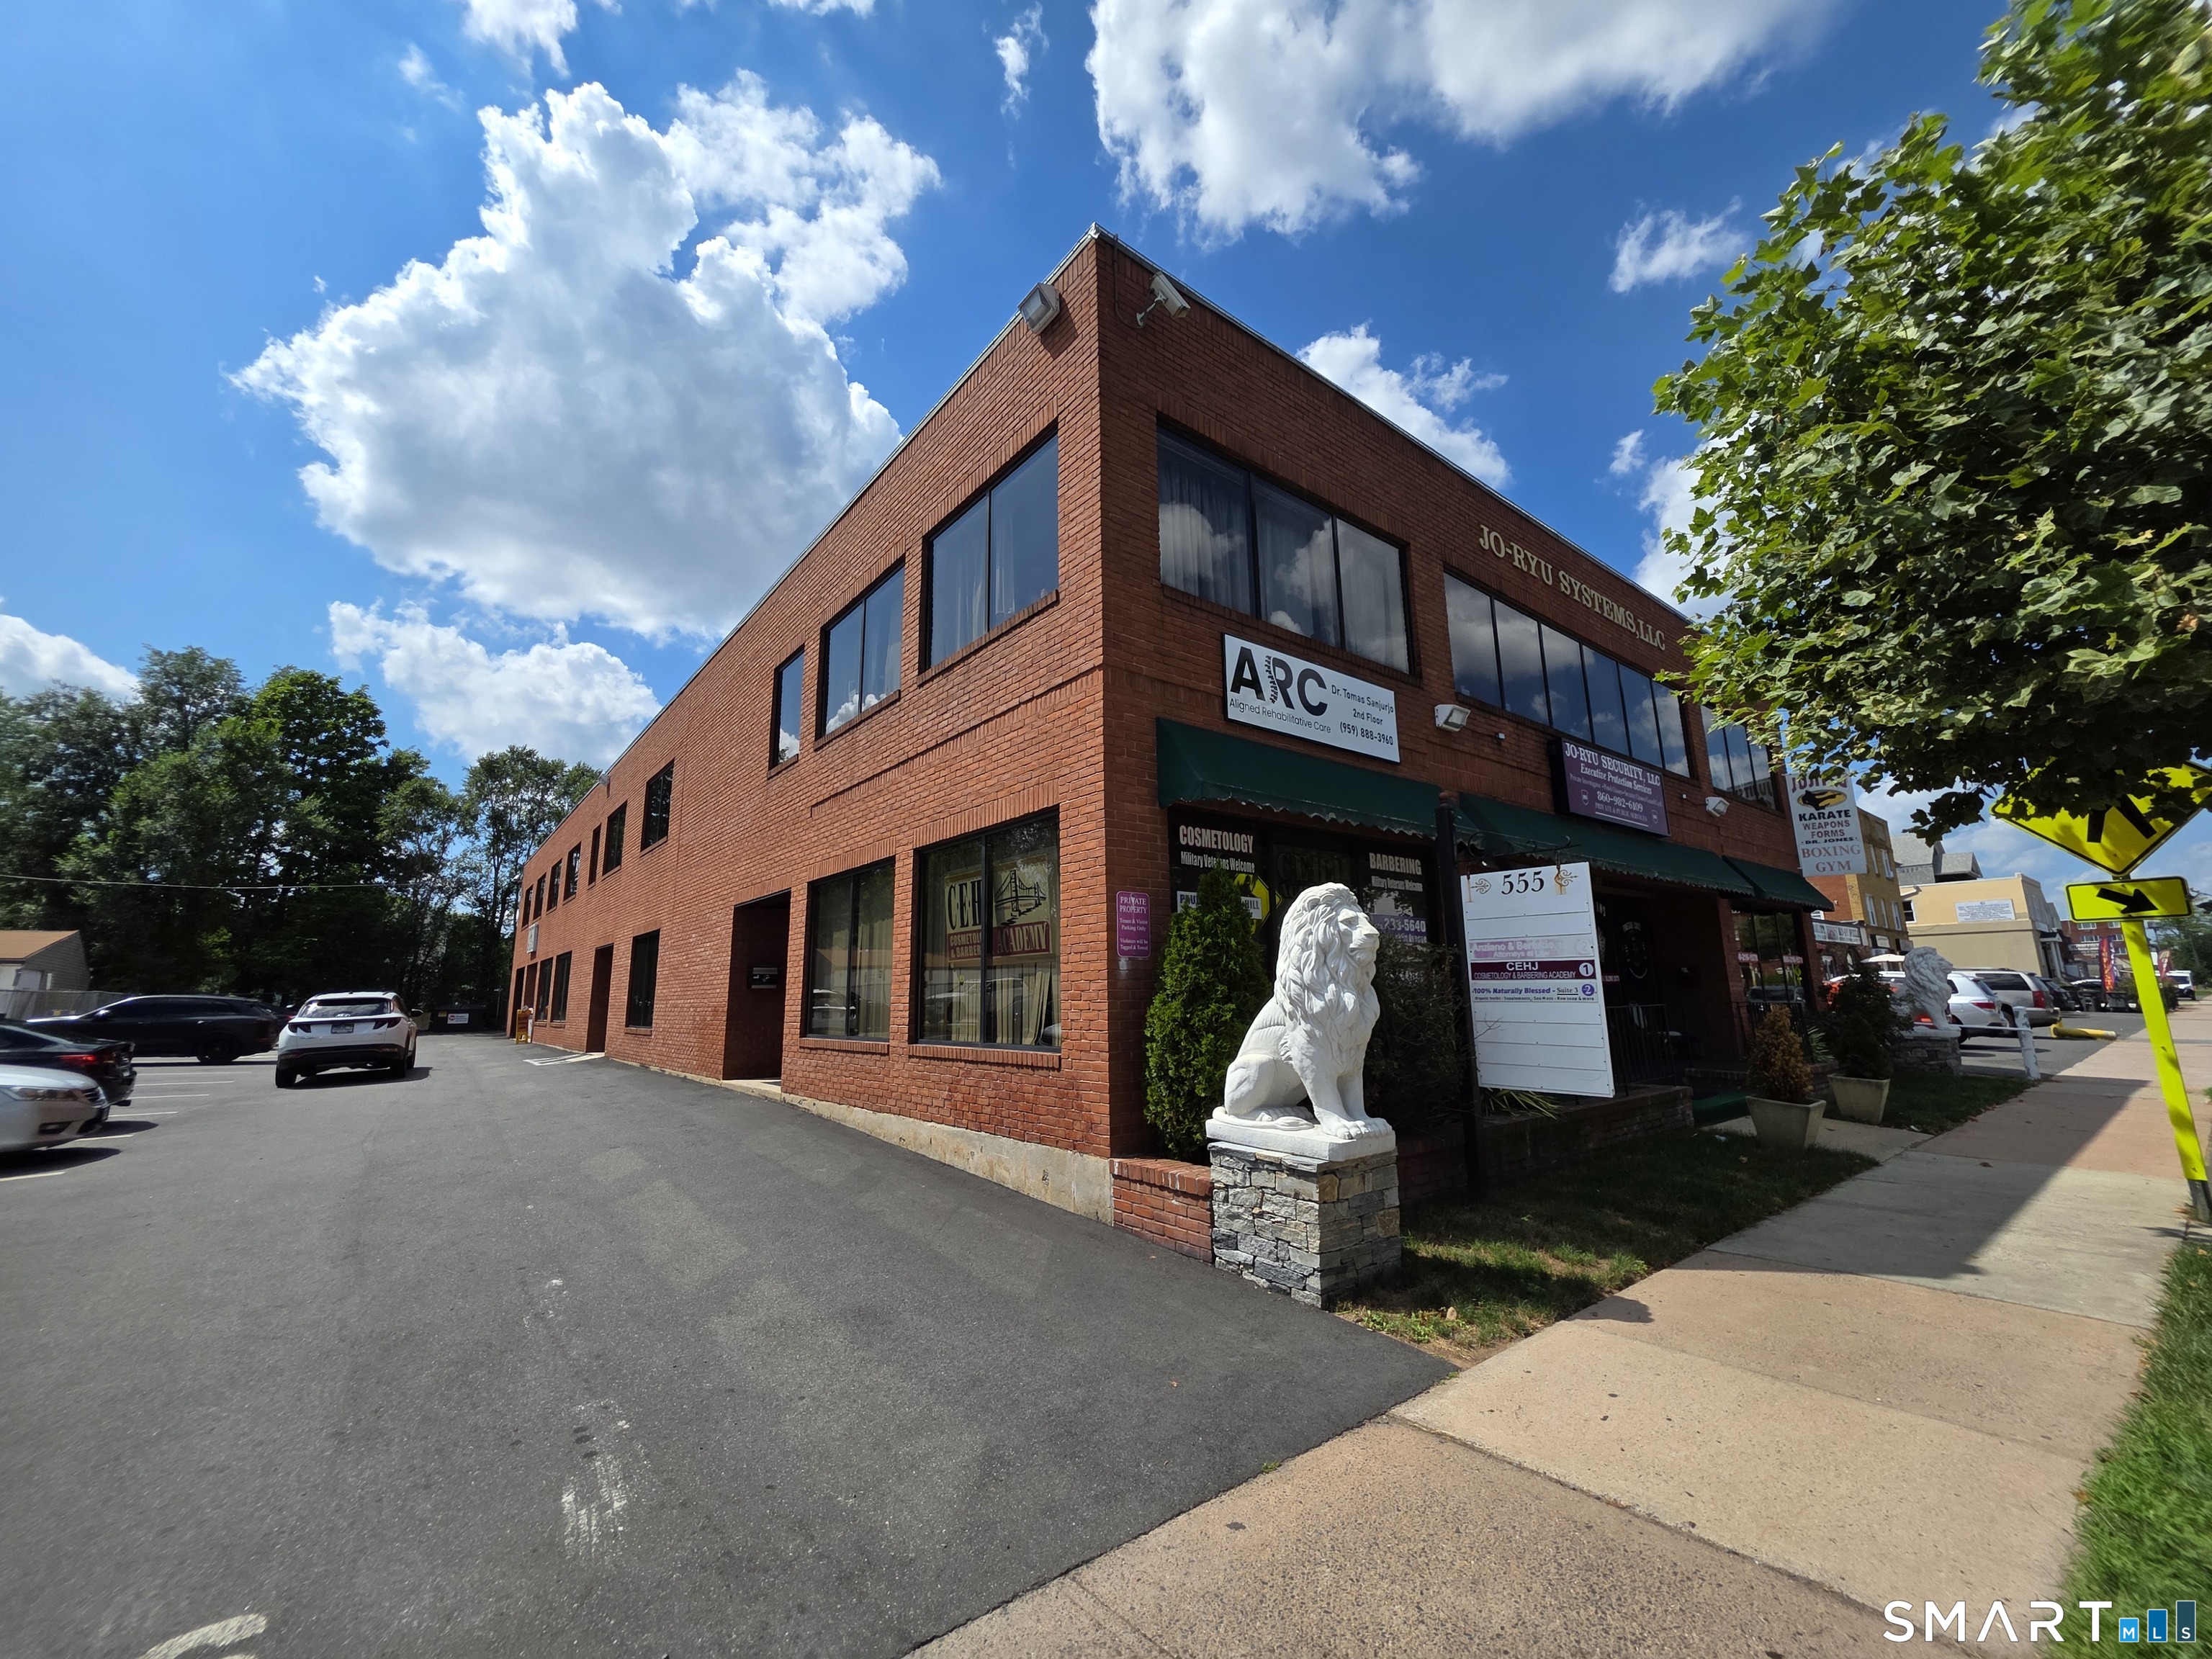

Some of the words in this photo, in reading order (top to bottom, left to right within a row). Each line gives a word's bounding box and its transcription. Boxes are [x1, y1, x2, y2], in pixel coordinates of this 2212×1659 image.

[1479, 524, 1552, 585] JO-RYU
[1231, 646, 1328, 716] ARC
[1331, 685, 1341, 696] Dr.
[1343, 688, 1365, 703] Tomas
[1367, 697, 1394, 714] Sanjurjo
[1230, 698, 1259, 714] Aligned
[1262, 707, 1313, 729] Rehabilitative
[1314, 721, 1331, 734] Care
[1353, 709, 1364, 720] 2nd
[1367, 713, 1383, 725] Floor
[1340, 721, 1358, 737] (959)
[1360, 727, 1393, 745] 888-3960
[1581, 763, 1606, 781] Executive
[1608, 772, 1632, 788] Protection
[1633, 781, 1652, 795] Services
[1601, 755, 1645, 783] SECURITY,
[1647, 773, 1660, 786] LLC
[1597, 791, 1643, 812] 860-982-6109
[1799, 809, 1851, 822] KARATE
[1802, 819, 1851, 830] WEAPONS
[1179, 824, 1254, 853] COSMETOLOGY
[1811, 829, 1845, 839] FORMS
[1181, 850, 1203, 868] Military
[1229, 858, 1255, 873] Welcome
[1801, 845, 1861, 858] BOXING
[1369, 853, 1422, 875] BARBERING
[1815, 860, 1851, 873] GYM
[1501, 870, 1545, 894] 555
[1120, 896, 1146, 905] PRIVATE
[1120, 905, 1147, 914] PROPERTY
[950, 931, 981, 947] COSMETOL
[997, 922, 1048, 954] ACADEMY
[950, 949, 956, 958] &
[956, 944, 981, 958] BARBER
[1506, 962, 1539, 971] CEHJ
